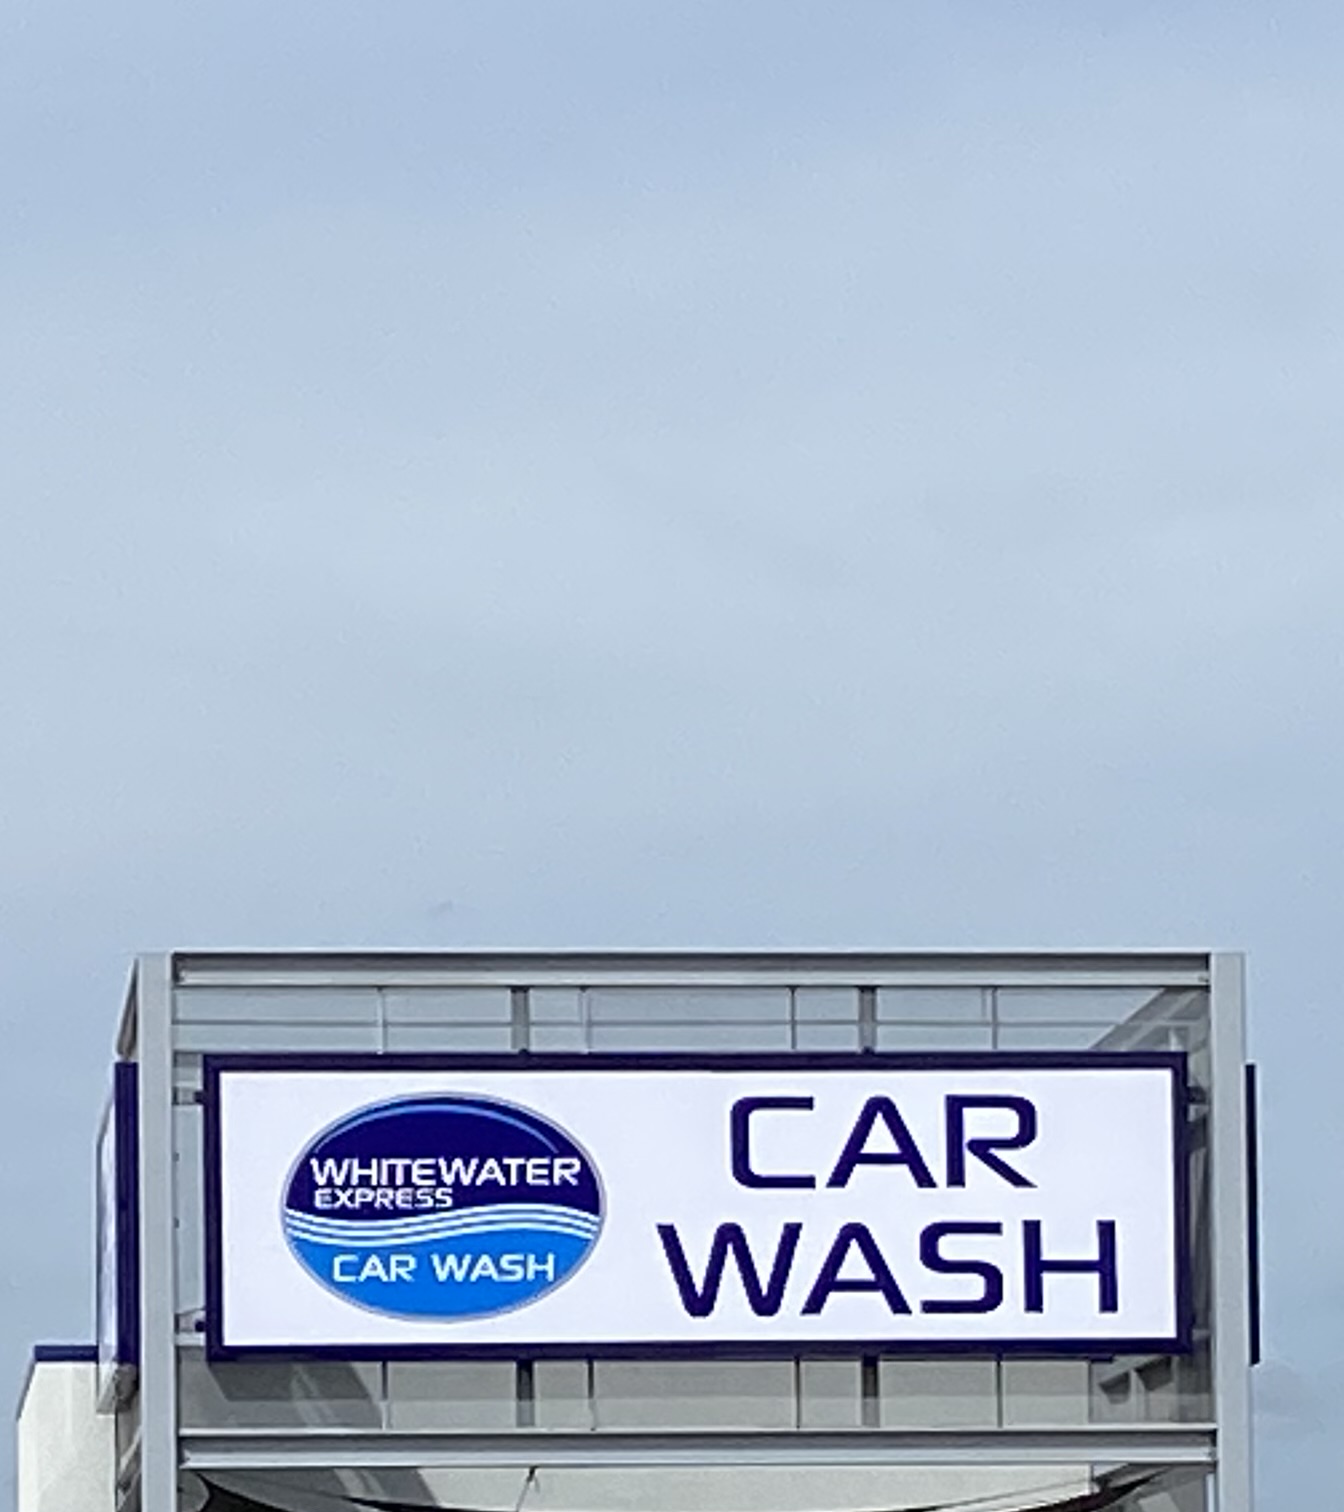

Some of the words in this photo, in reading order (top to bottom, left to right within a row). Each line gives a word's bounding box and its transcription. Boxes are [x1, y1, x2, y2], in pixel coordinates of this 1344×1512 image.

[730, 1094, 1038, 1190] CAR
[310, 1156, 581, 1187] WHITEWATER
[314, 1187, 454, 1210] EXPRESS
[332, 1253, 418, 1283] CAR
[430, 1253, 556, 1283] WASH
[656, 1219, 1119, 1318] WASH
